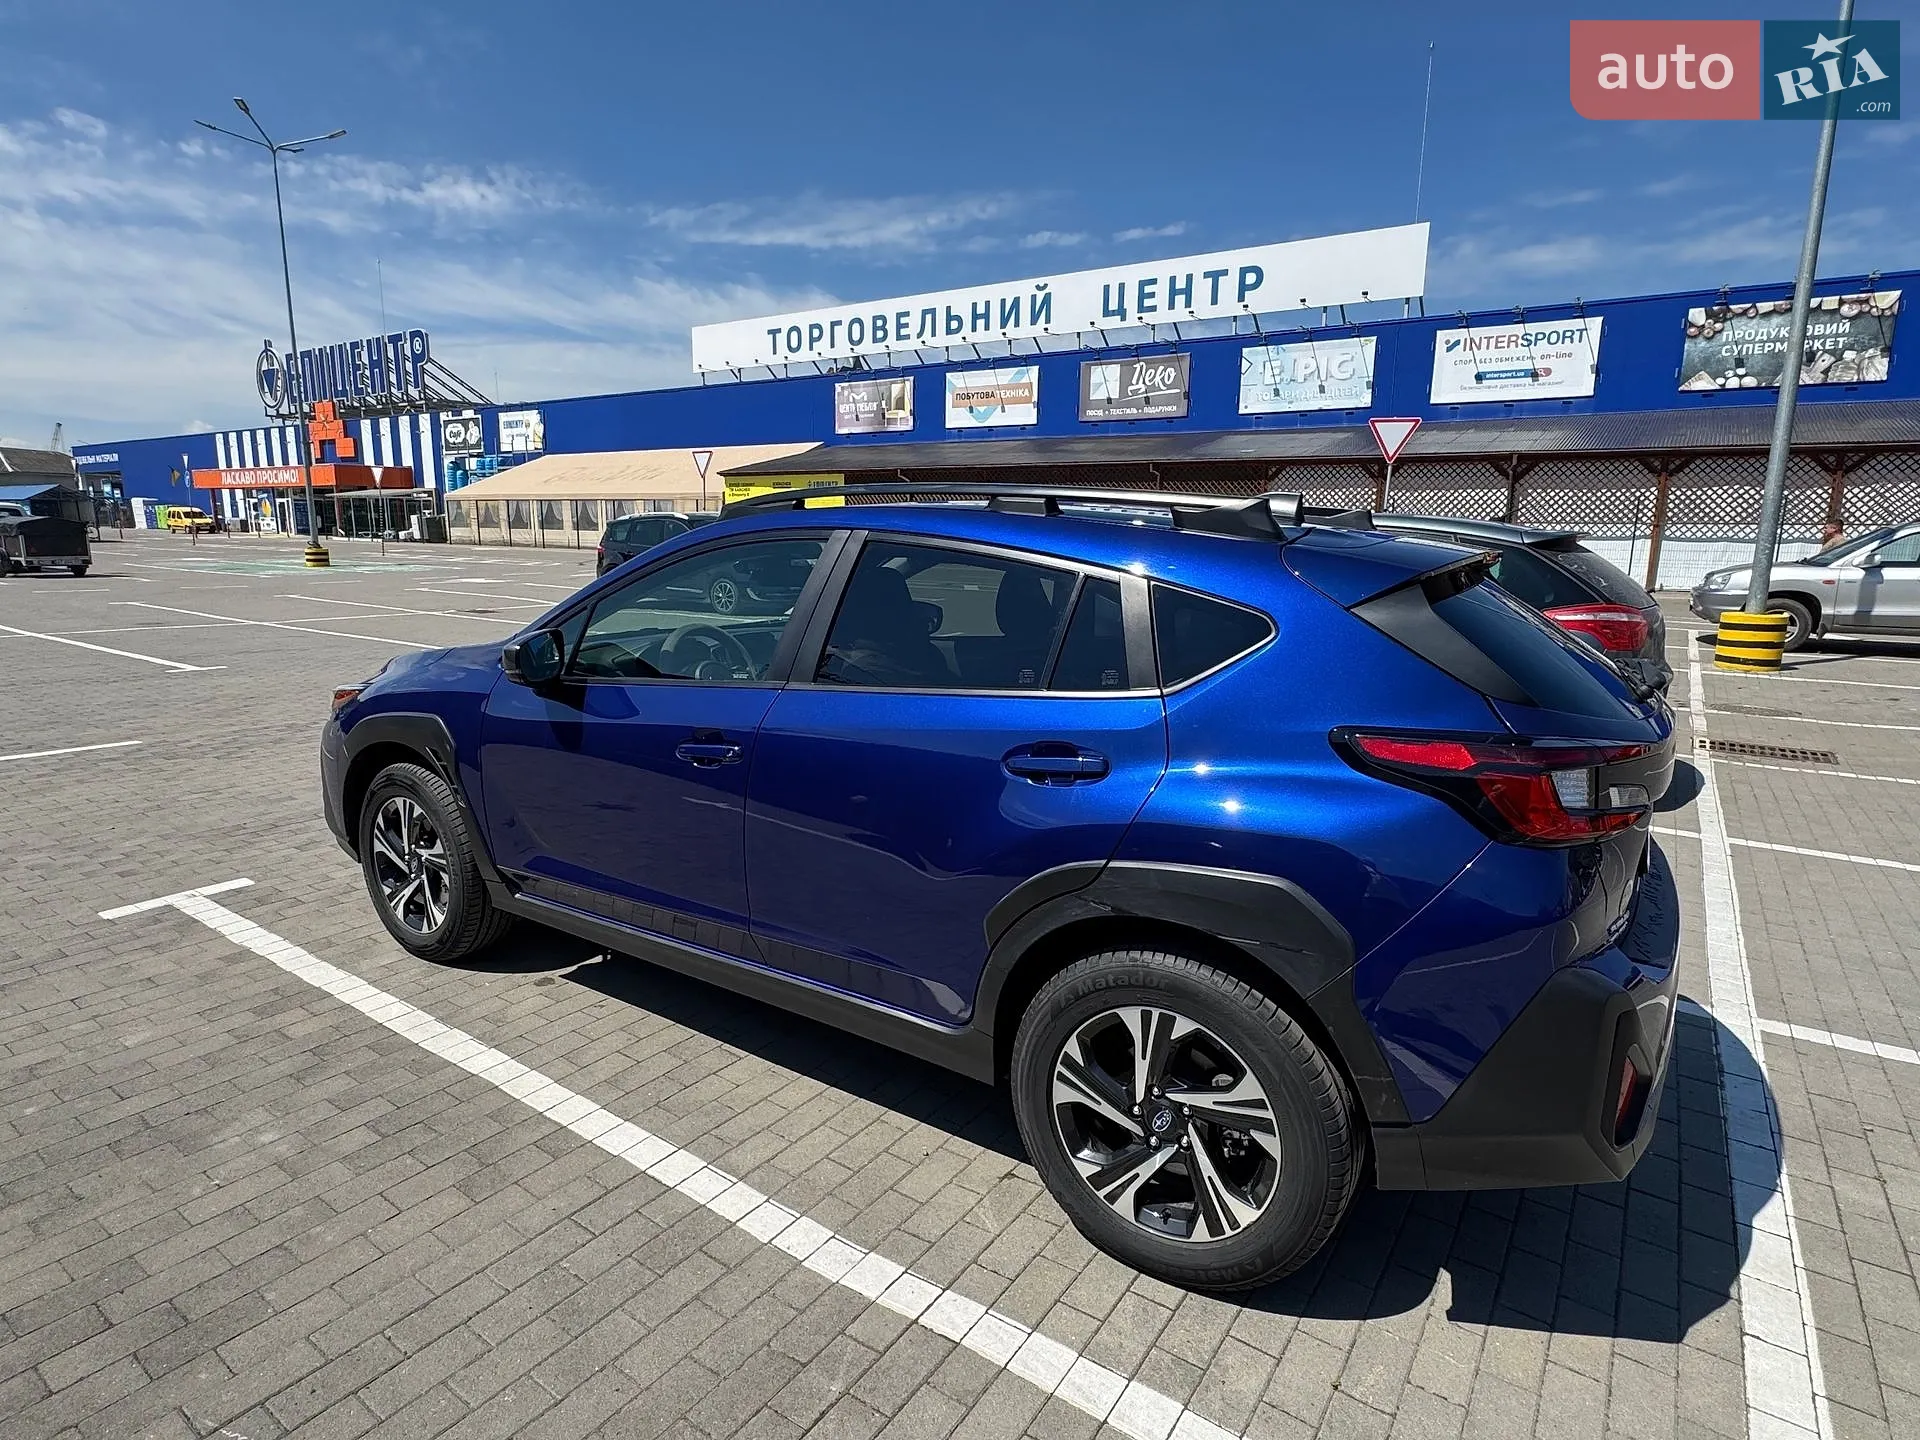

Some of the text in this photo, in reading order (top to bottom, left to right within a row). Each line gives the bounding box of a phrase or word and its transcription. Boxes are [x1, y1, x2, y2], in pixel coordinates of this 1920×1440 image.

[767, 265, 1265, 356] ТОРГОВЕЛЬНИЙ ЦЕНТР
[1463, 328, 1588, 352] INTERSPORT
[1722, 319, 1851, 342] ПРОДУКОВИЙ
[1540, 351, 1573, 360] on-line
[1721, 336, 1847, 356] СУПЕРМРКЕТ
[1127, 361, 1177, 396] Деко
[955, 388, 1030, 401] ПОБУТОВА ТЕХНІКА
[221, 468, 300, 485] ЛАСКАВО ПРОСИМО!
